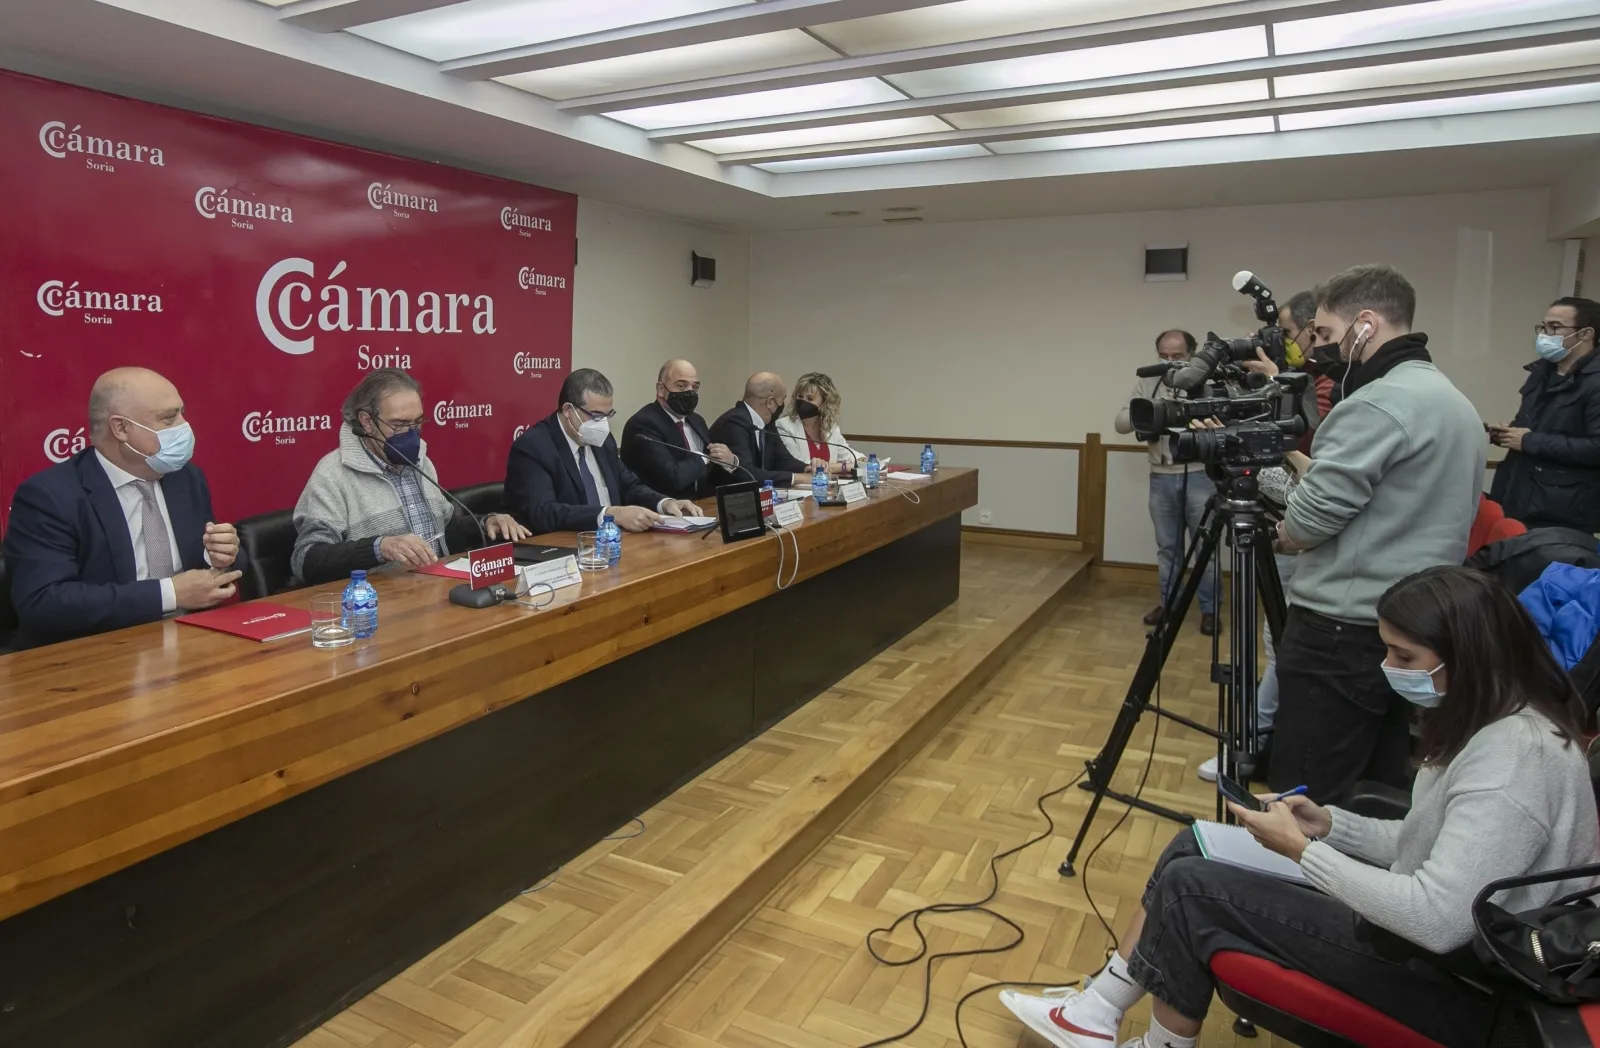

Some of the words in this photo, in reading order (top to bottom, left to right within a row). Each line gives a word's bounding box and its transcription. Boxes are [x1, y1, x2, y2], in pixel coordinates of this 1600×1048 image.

[86, 158, 115, 173] Soria
[393, 208, 410, 219] Soria
[231, 218, 254, 230] Soria
[84, 312, 113, 325] Soria
[357, 344, 412, 370] Soria
[275, 435, 296, 445] Soria
[484, 568, 505, 578] Soria
